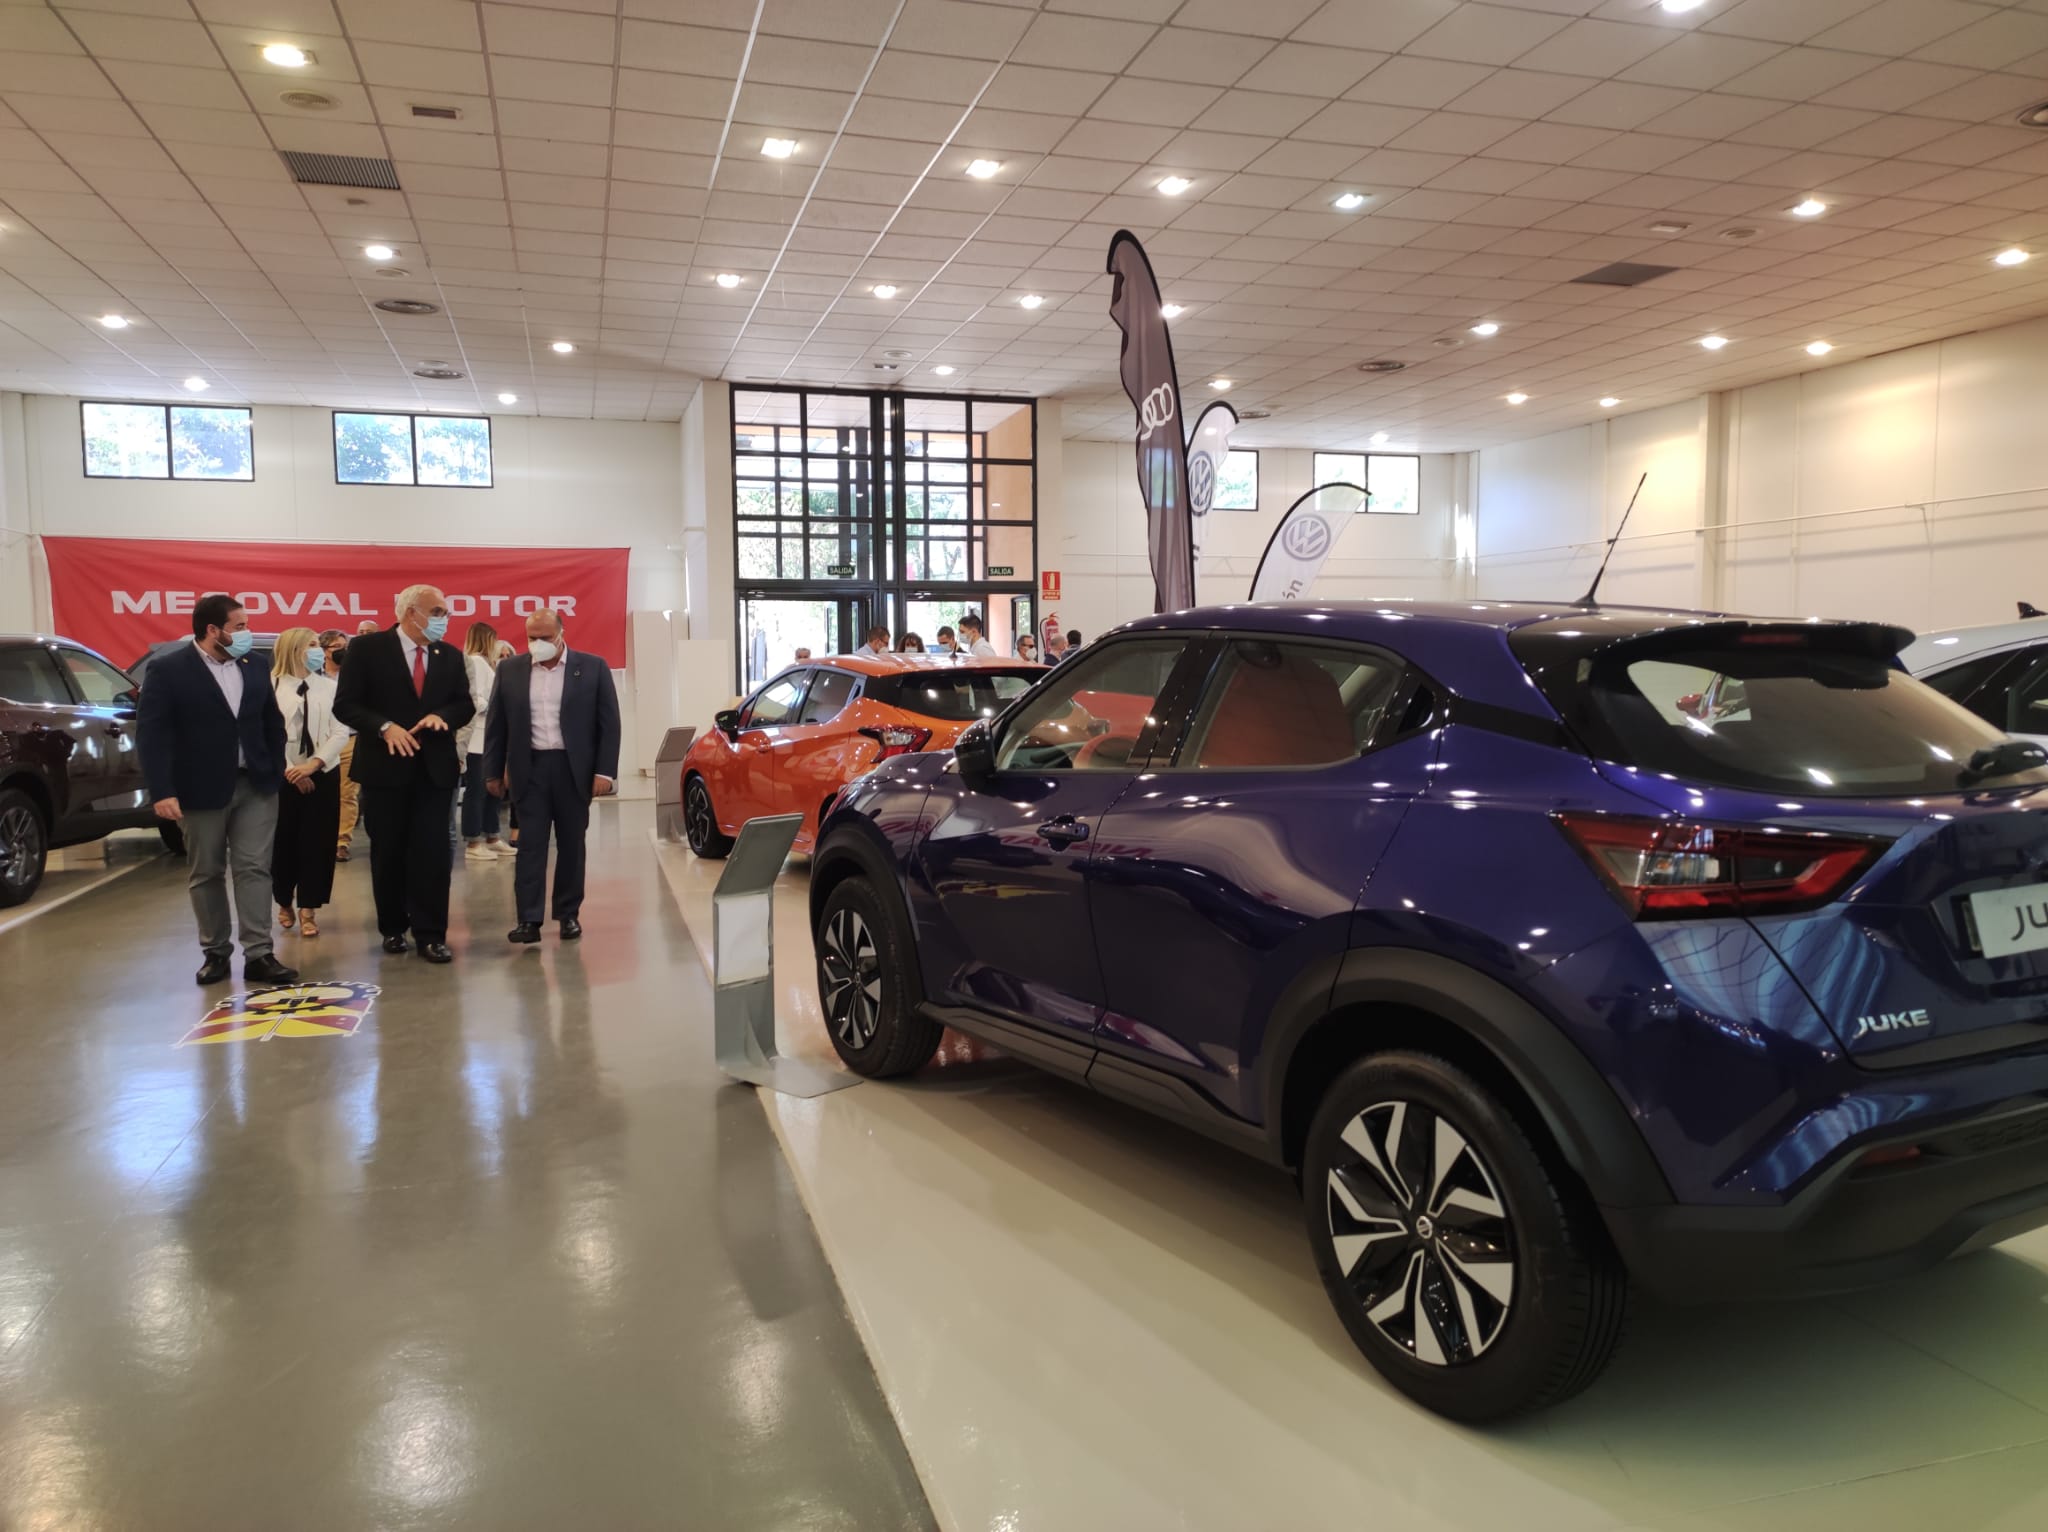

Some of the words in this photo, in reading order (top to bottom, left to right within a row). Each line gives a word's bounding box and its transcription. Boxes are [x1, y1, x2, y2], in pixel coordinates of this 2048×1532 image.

[829, 566, 854, 574] SALIDA
[989, 567, 1012, 575] SALIDA
[394, 592, 577, 617] OTOR
[1852, 1008, 1931, 1040] JUKE
